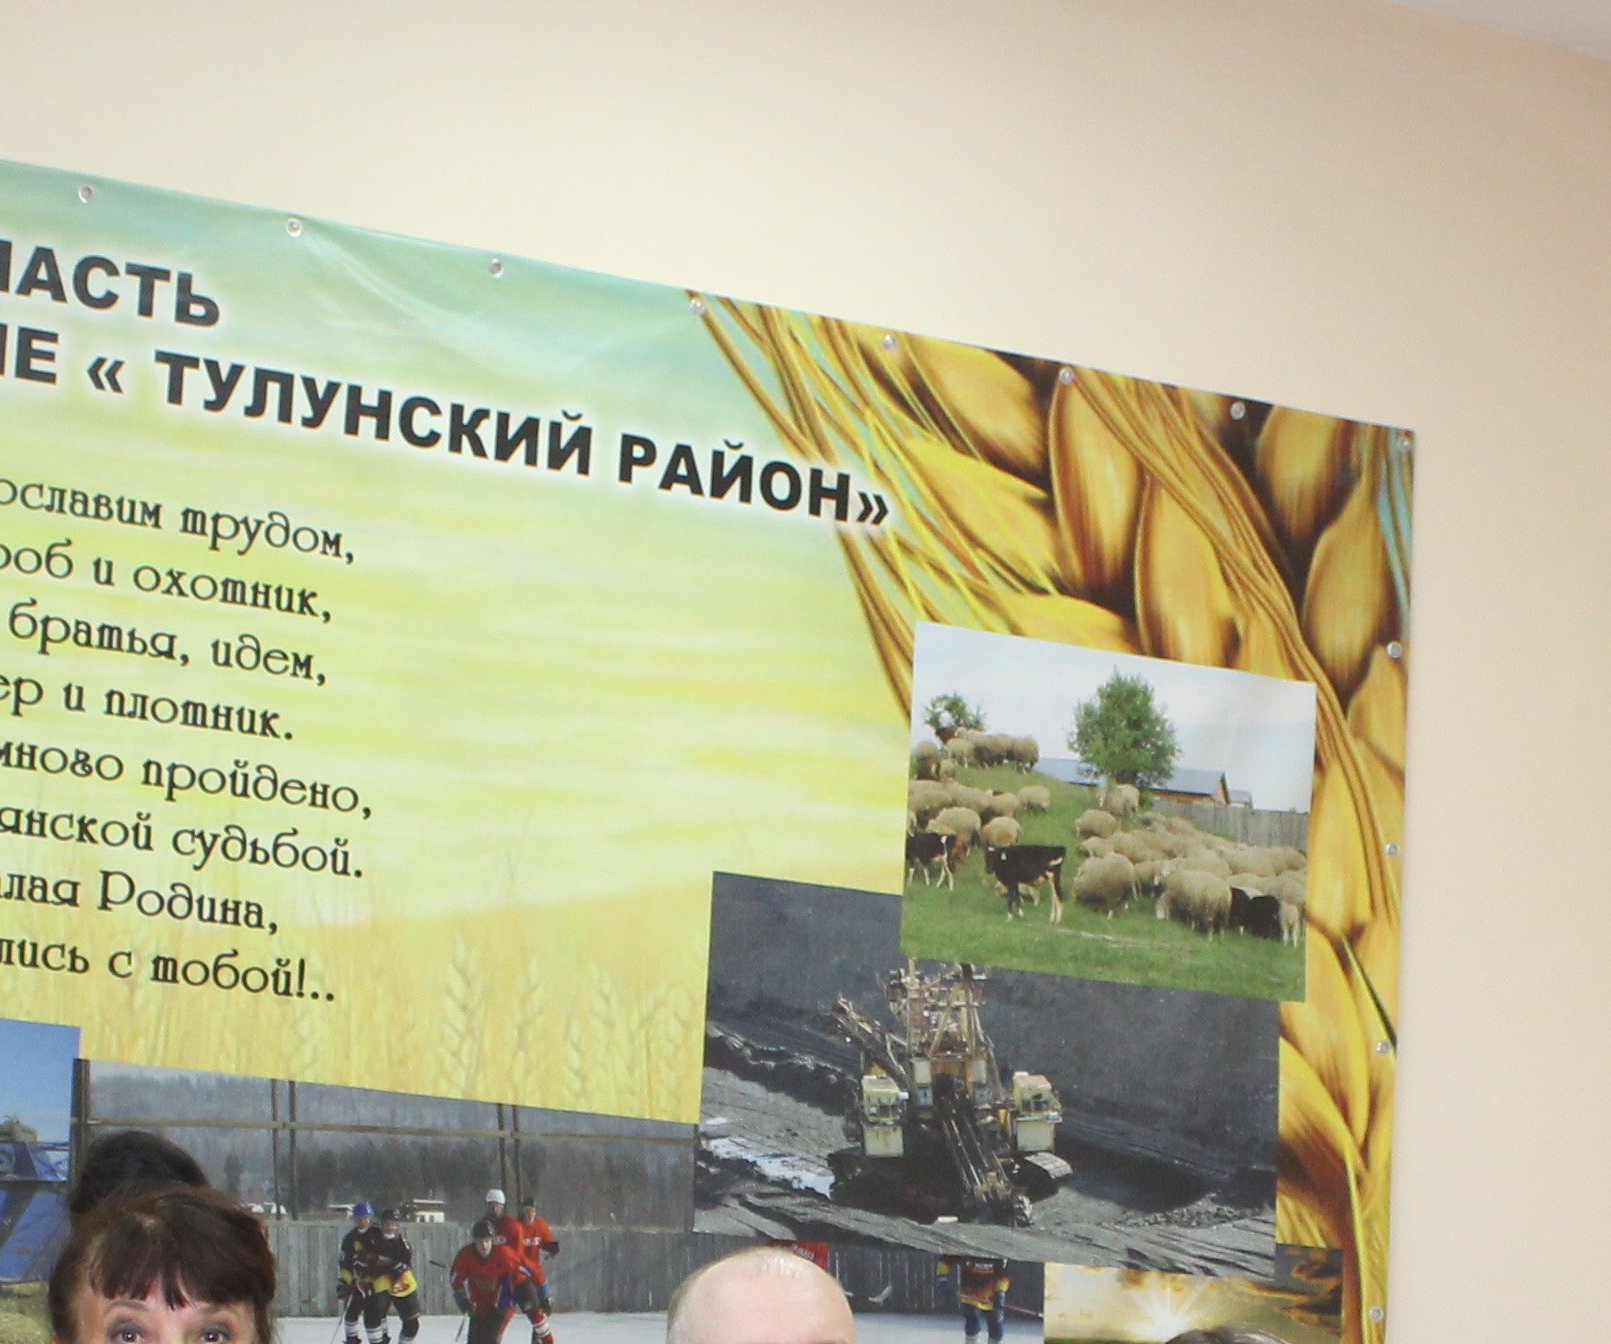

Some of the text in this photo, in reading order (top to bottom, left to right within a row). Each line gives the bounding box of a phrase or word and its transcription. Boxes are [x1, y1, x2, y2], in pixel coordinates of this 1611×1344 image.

[154, 349, 593, 477] ТУЛУНСКИЙ
[618, 432, 889, 526] РАЙОН»
[179, 506, 354, 565] трудом,
[92, 556, 115, 587] и
[132, 565, 331, 624] охотник,
[8, 597, 190, 668] братья,
[210, 633, 326, 687] идем,
[62, 681, 86, 713] и
[103, 688, 293, 741] плотник.
[140, 758, 372, 821] пройдено,
[171, 823, 363, 879] судьбой.
[96, 869, 278, 936] Родина,
[107, 950, 133, 979] с
[149, 948, 335, 1002] тобой!..
